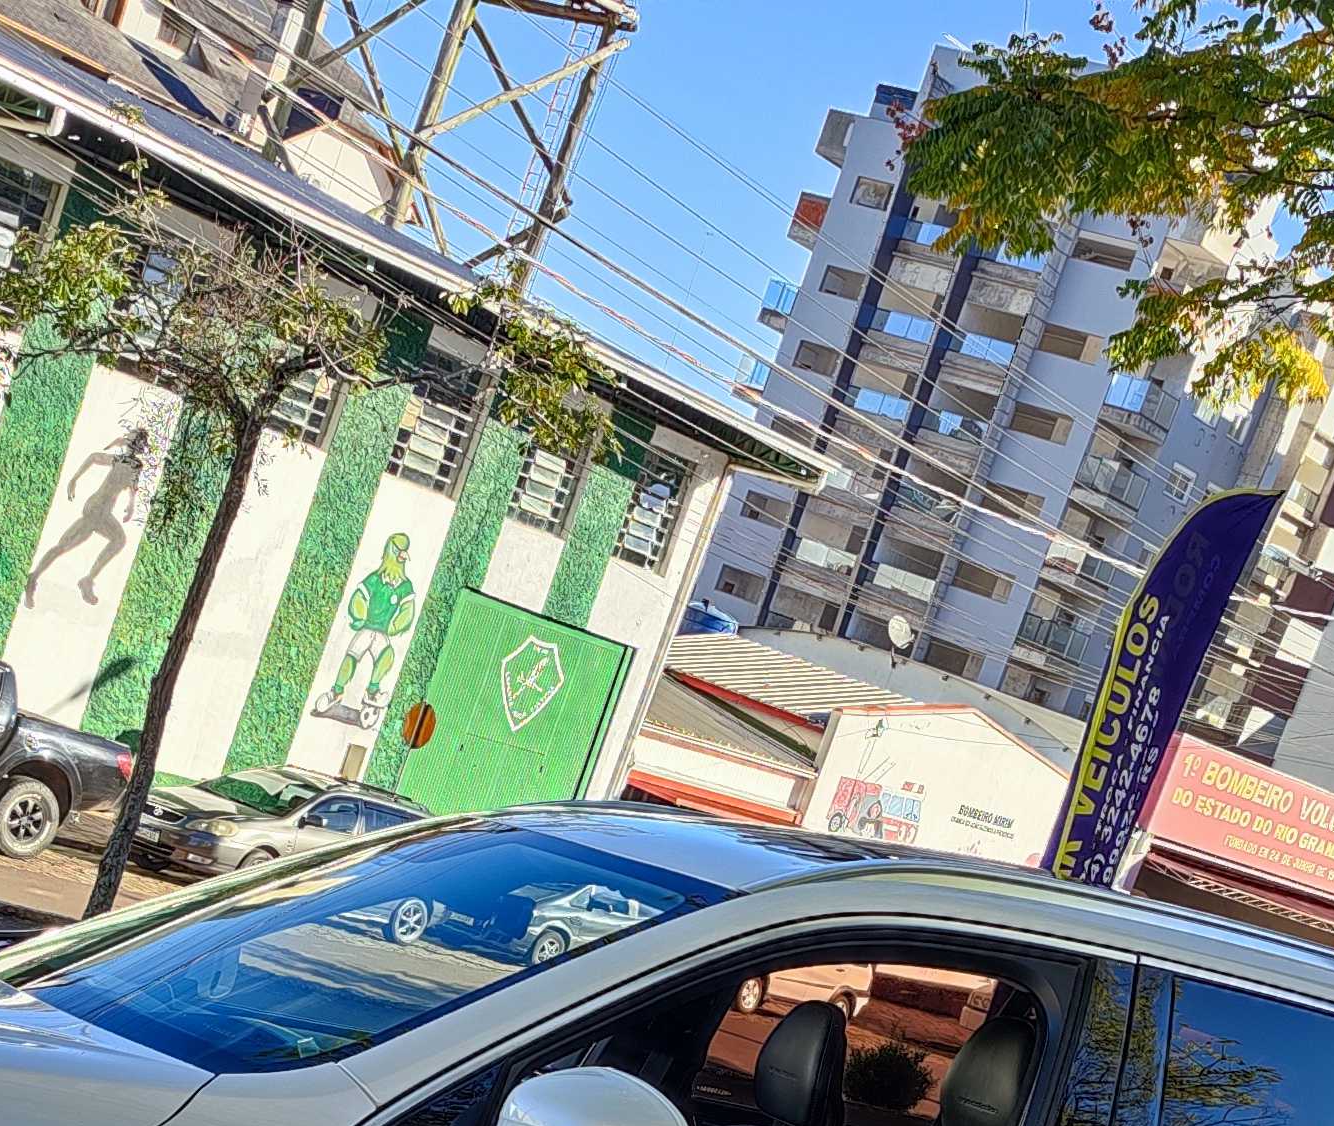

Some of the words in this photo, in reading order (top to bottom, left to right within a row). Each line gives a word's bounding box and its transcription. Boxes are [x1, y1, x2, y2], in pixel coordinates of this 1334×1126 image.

[1127, 615, 1170, 732] FINANCIA
[1101, 687, 1160, 843] 3242-4678
[1202, 761, 1294, 813] BOMBEIRO
[1172, 787, 1192, 808] DO
[1195, 796, 1251, 831] ESTADO
[1252, 816, 1272, 836] DO
[1274, 823, 1297, 846] RIO
